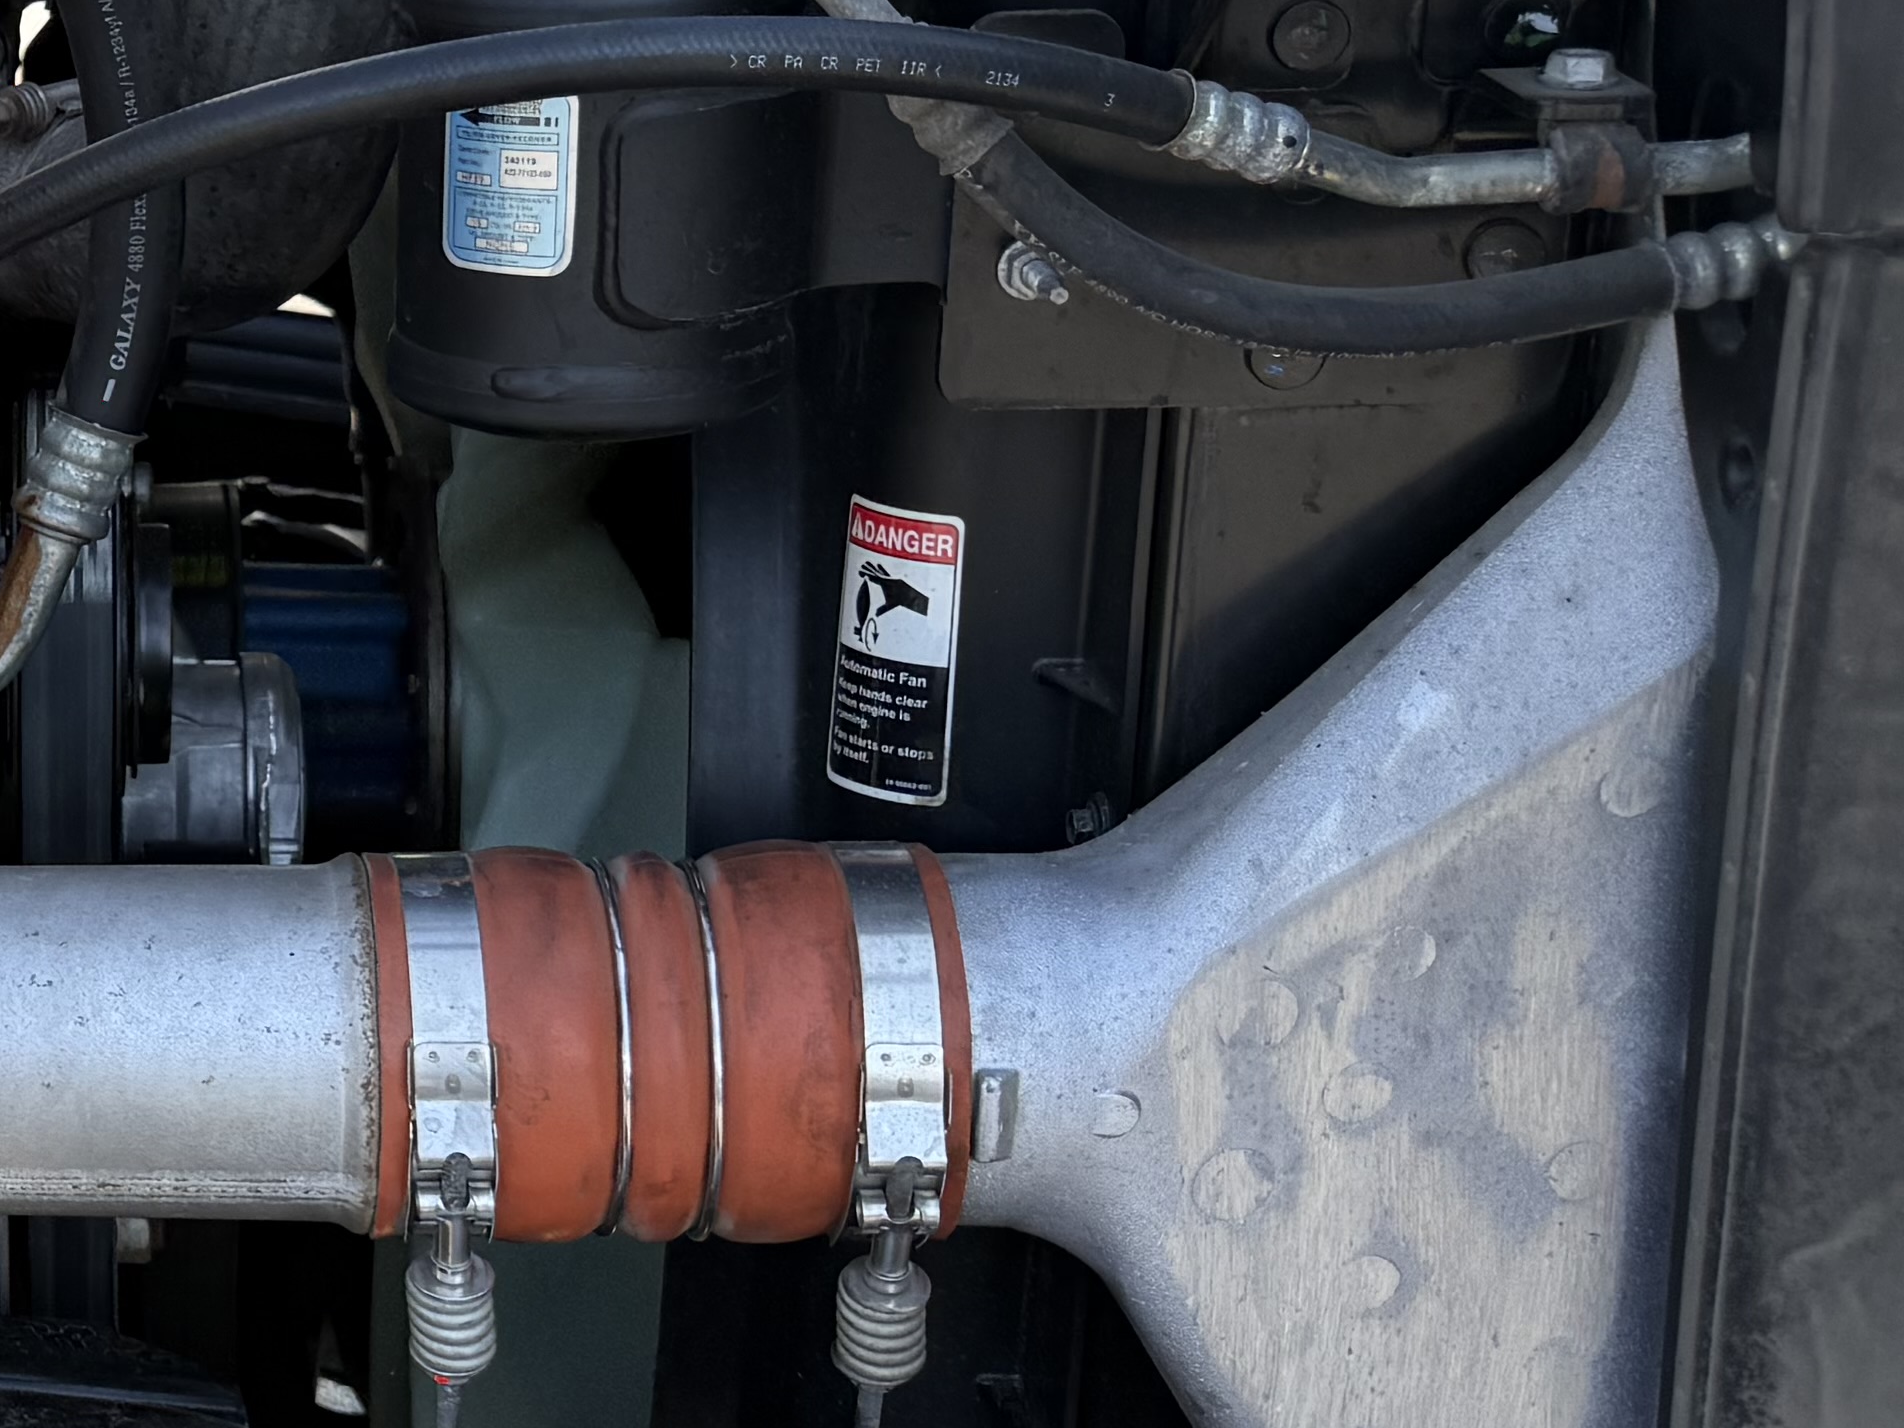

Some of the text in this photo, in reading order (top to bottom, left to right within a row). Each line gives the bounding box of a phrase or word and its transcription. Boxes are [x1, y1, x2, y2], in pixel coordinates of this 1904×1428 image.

[748, 55, 768, 69] CR
[784, 55, 804, 70] PA
[820, 56, 840, 71] CR
[855, 57, 883, 74] PET
[985, 71, 1020, 88] 2134
[1104, 92, 1116, 108] 3
[109, 193, 148, 371] GALAXY 4880 Flex
[863, 520, 954, 558] DANGER
[840, 654, 927, 689] Automatic Fan
[859, 685, 892, 704] hands
[895, 695, 928, 709] clear
[859, 702, 896, 720] engine
[899, 709, 911, 722] is
[834, 725, 934, 761] Fan starts or stops
